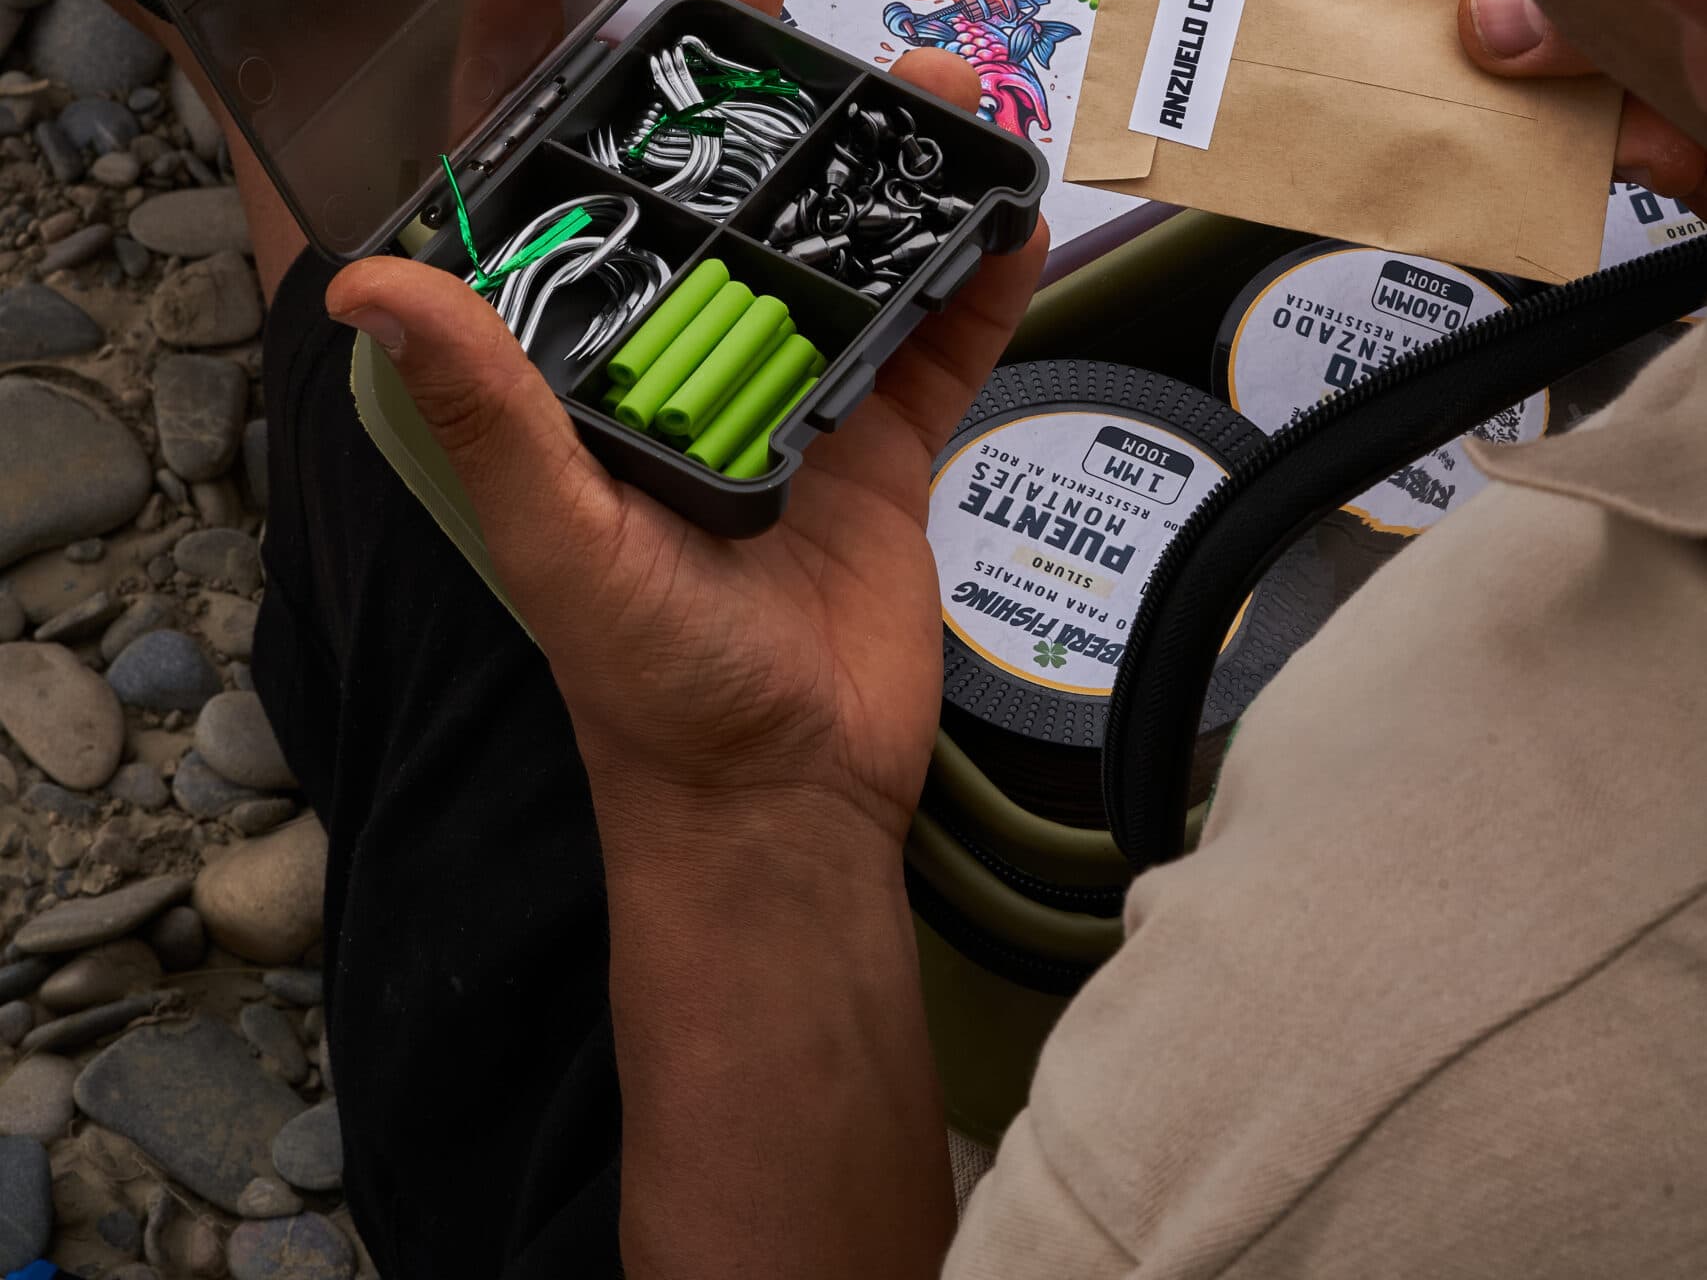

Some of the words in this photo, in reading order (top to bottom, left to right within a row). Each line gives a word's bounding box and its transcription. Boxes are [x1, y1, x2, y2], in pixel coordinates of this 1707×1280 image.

[1159, 16, 1208, 129] ANZUELO
[1666, 222, 1706, 239] LURO
[1404, 270, 1451, 297] 300M
[1287, 293, 1394, 342] RESISTENCIA
[1377, 285, 1462, 331] 0,60MM
[1272, 307, 1398, 365] ENZADO
[980, 444, 1020, 467] ROCE
[1028, 462, 1045, 476] AL
[1104, 455, 1144, 486] MM
[1122, 437, 1171, 465] 100M
[972, 461, 1126, 536] MONTAJES
[1052, 472, 1151, 519] RESISTENCIA
[1148, 473, 1164, 493] 1
[959, 481, 1136, 574] PUENTE
[974, 560, 1059, 602] MONTAJES
[1032, 557, 1093, 589] SILURO
[951, 581, 1059, 639] FISHING
[1066, 597, 1108, 623] PARA
[1053, 624, 1127, 667] BERA
